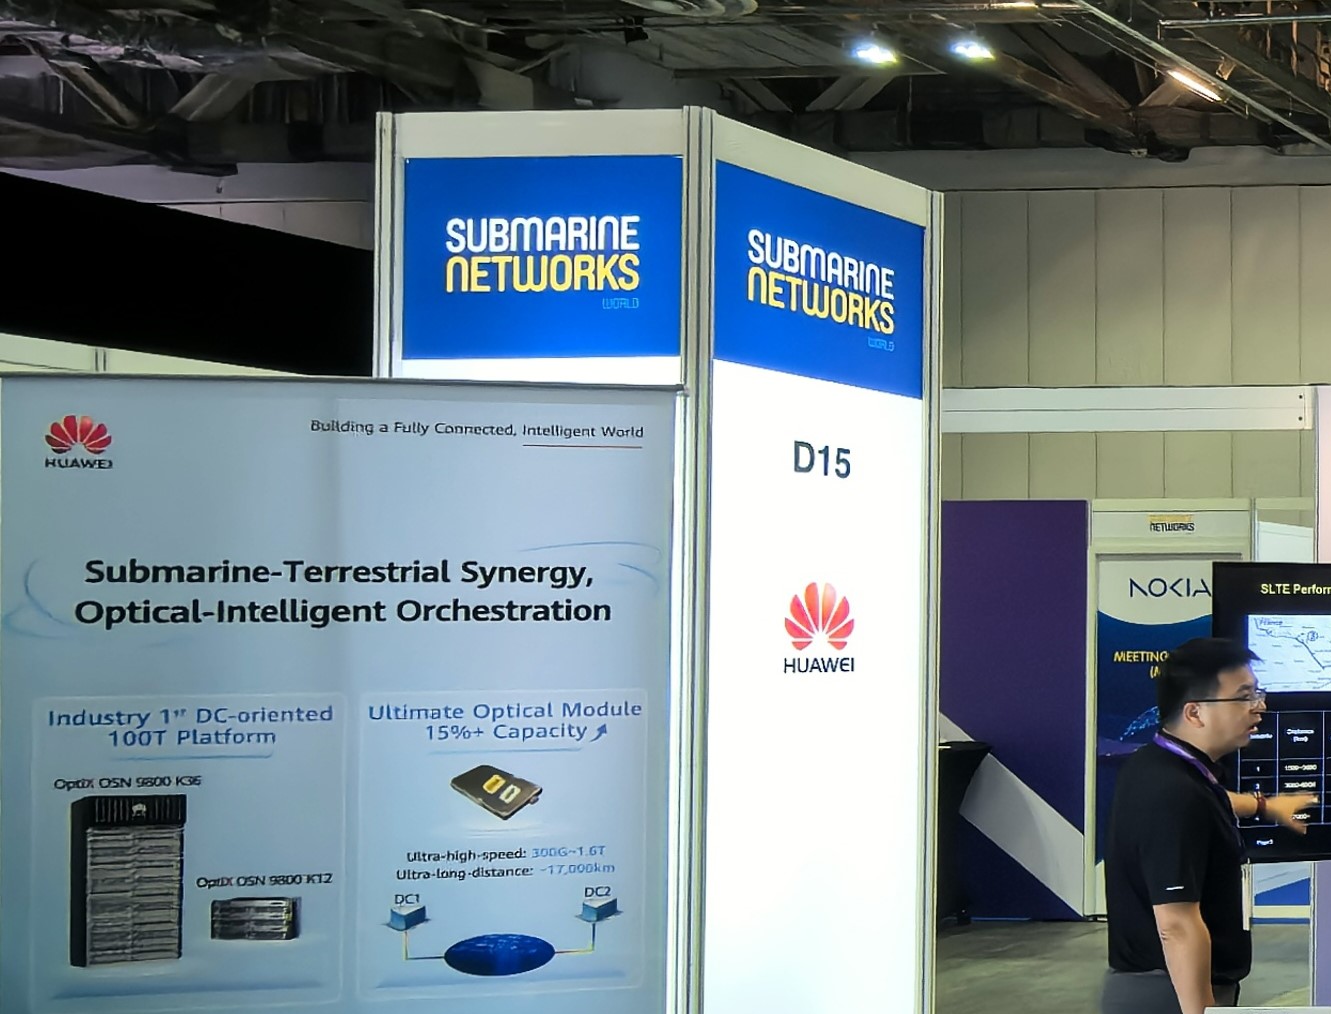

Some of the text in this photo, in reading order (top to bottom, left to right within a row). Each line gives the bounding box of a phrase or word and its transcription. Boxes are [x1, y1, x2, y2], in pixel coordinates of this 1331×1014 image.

[445, 215, 640, 253] SUBMARINE
[446, 253, 640, 294] NETWORKS
[747, 228, 895, 300] SUBMARINE
[602, 297, 640, 309] WORLD
[747, 266, 895, 335] NETWORKS
[310, 419, 644, 439] Building a Fully Connected, Intelligent World
[45, 457, 113, 469] HUAWEI
[793, 441, 851, 479] D15
[84, 558, 594, 589] Submarine-Terrestrial Synergy,
[1129, 578, 1212, 598] NOKIA
[1260, 583, 1290, 595] SLTE
[75, 598, 611, 630] Optical-Intelligent Orchestration
[783, 656, 855, 674] HUAWEI
[49, 709, 150, 729] Industry
[196, 705, 333, 724] DC-oriented
[368, 701, 642, 722] Ultimate Optical Module
[108, 727, 276, 747] 100T Platform
[425, 723, 588, 742] 15%+ Capacity
[99, 776, 131, 789] OSN
[407, 847, 527, 864] Ultra-high-speed:
[396, 865, 534, 881] Ultra-long-distance:
[584, 886, 611, 898] DC2
